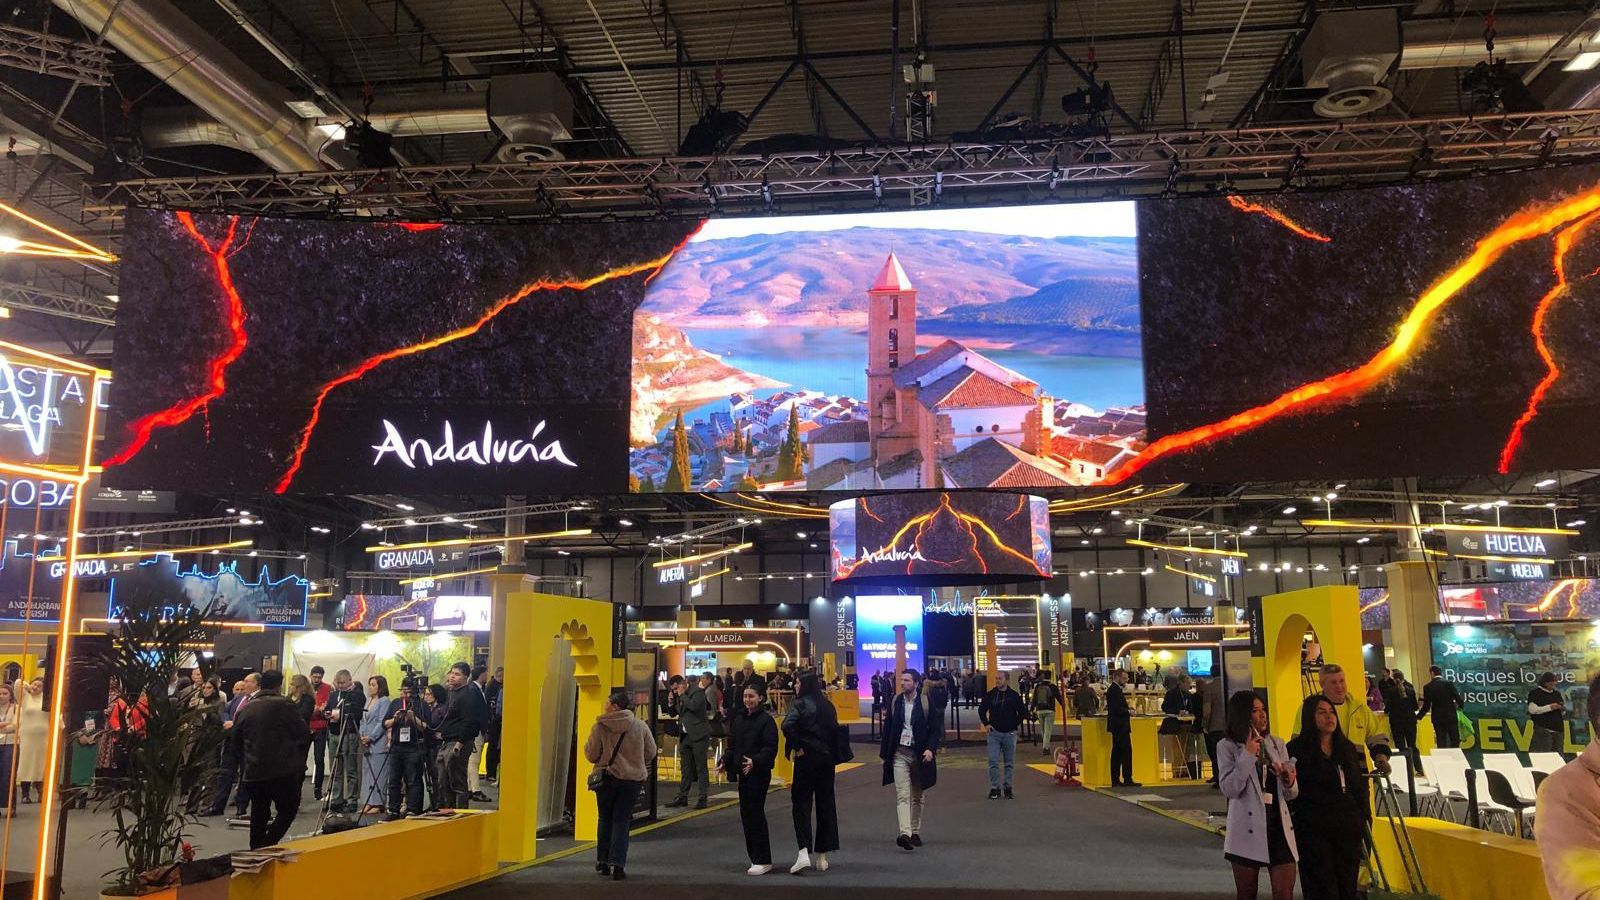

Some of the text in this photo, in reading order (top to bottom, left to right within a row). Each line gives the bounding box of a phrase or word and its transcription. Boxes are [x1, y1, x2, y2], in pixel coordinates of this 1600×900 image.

[0, 367, 84, 404] STA
[371, 419, 578, 468] Andalucía
[1485, 534, 1546, 553] HUELVA
[379, 549, 434, 569] GRANADA
[861, 543, 927, 564] Andalucía
[50, 560, 107, 578] GRNADA
[1511, 563, 1544, 579] HUELVA
[897, 588, 1009, 617] dalucía
[837, 601, 846, 647] BUSINESS
[1170, 616, 1216, 625] ANDALUSIA
[703, 634, 743, 643] ALMERÍA
[845, 620, 854, 647] AREA
[1060, 619, 1069, 646] AREA
[1173, 630, 1200, 641] JAÉN
[862, 641, 918, 651] SATISFACÓN
[1445, 667, 1576, 686] Busques lo ue
